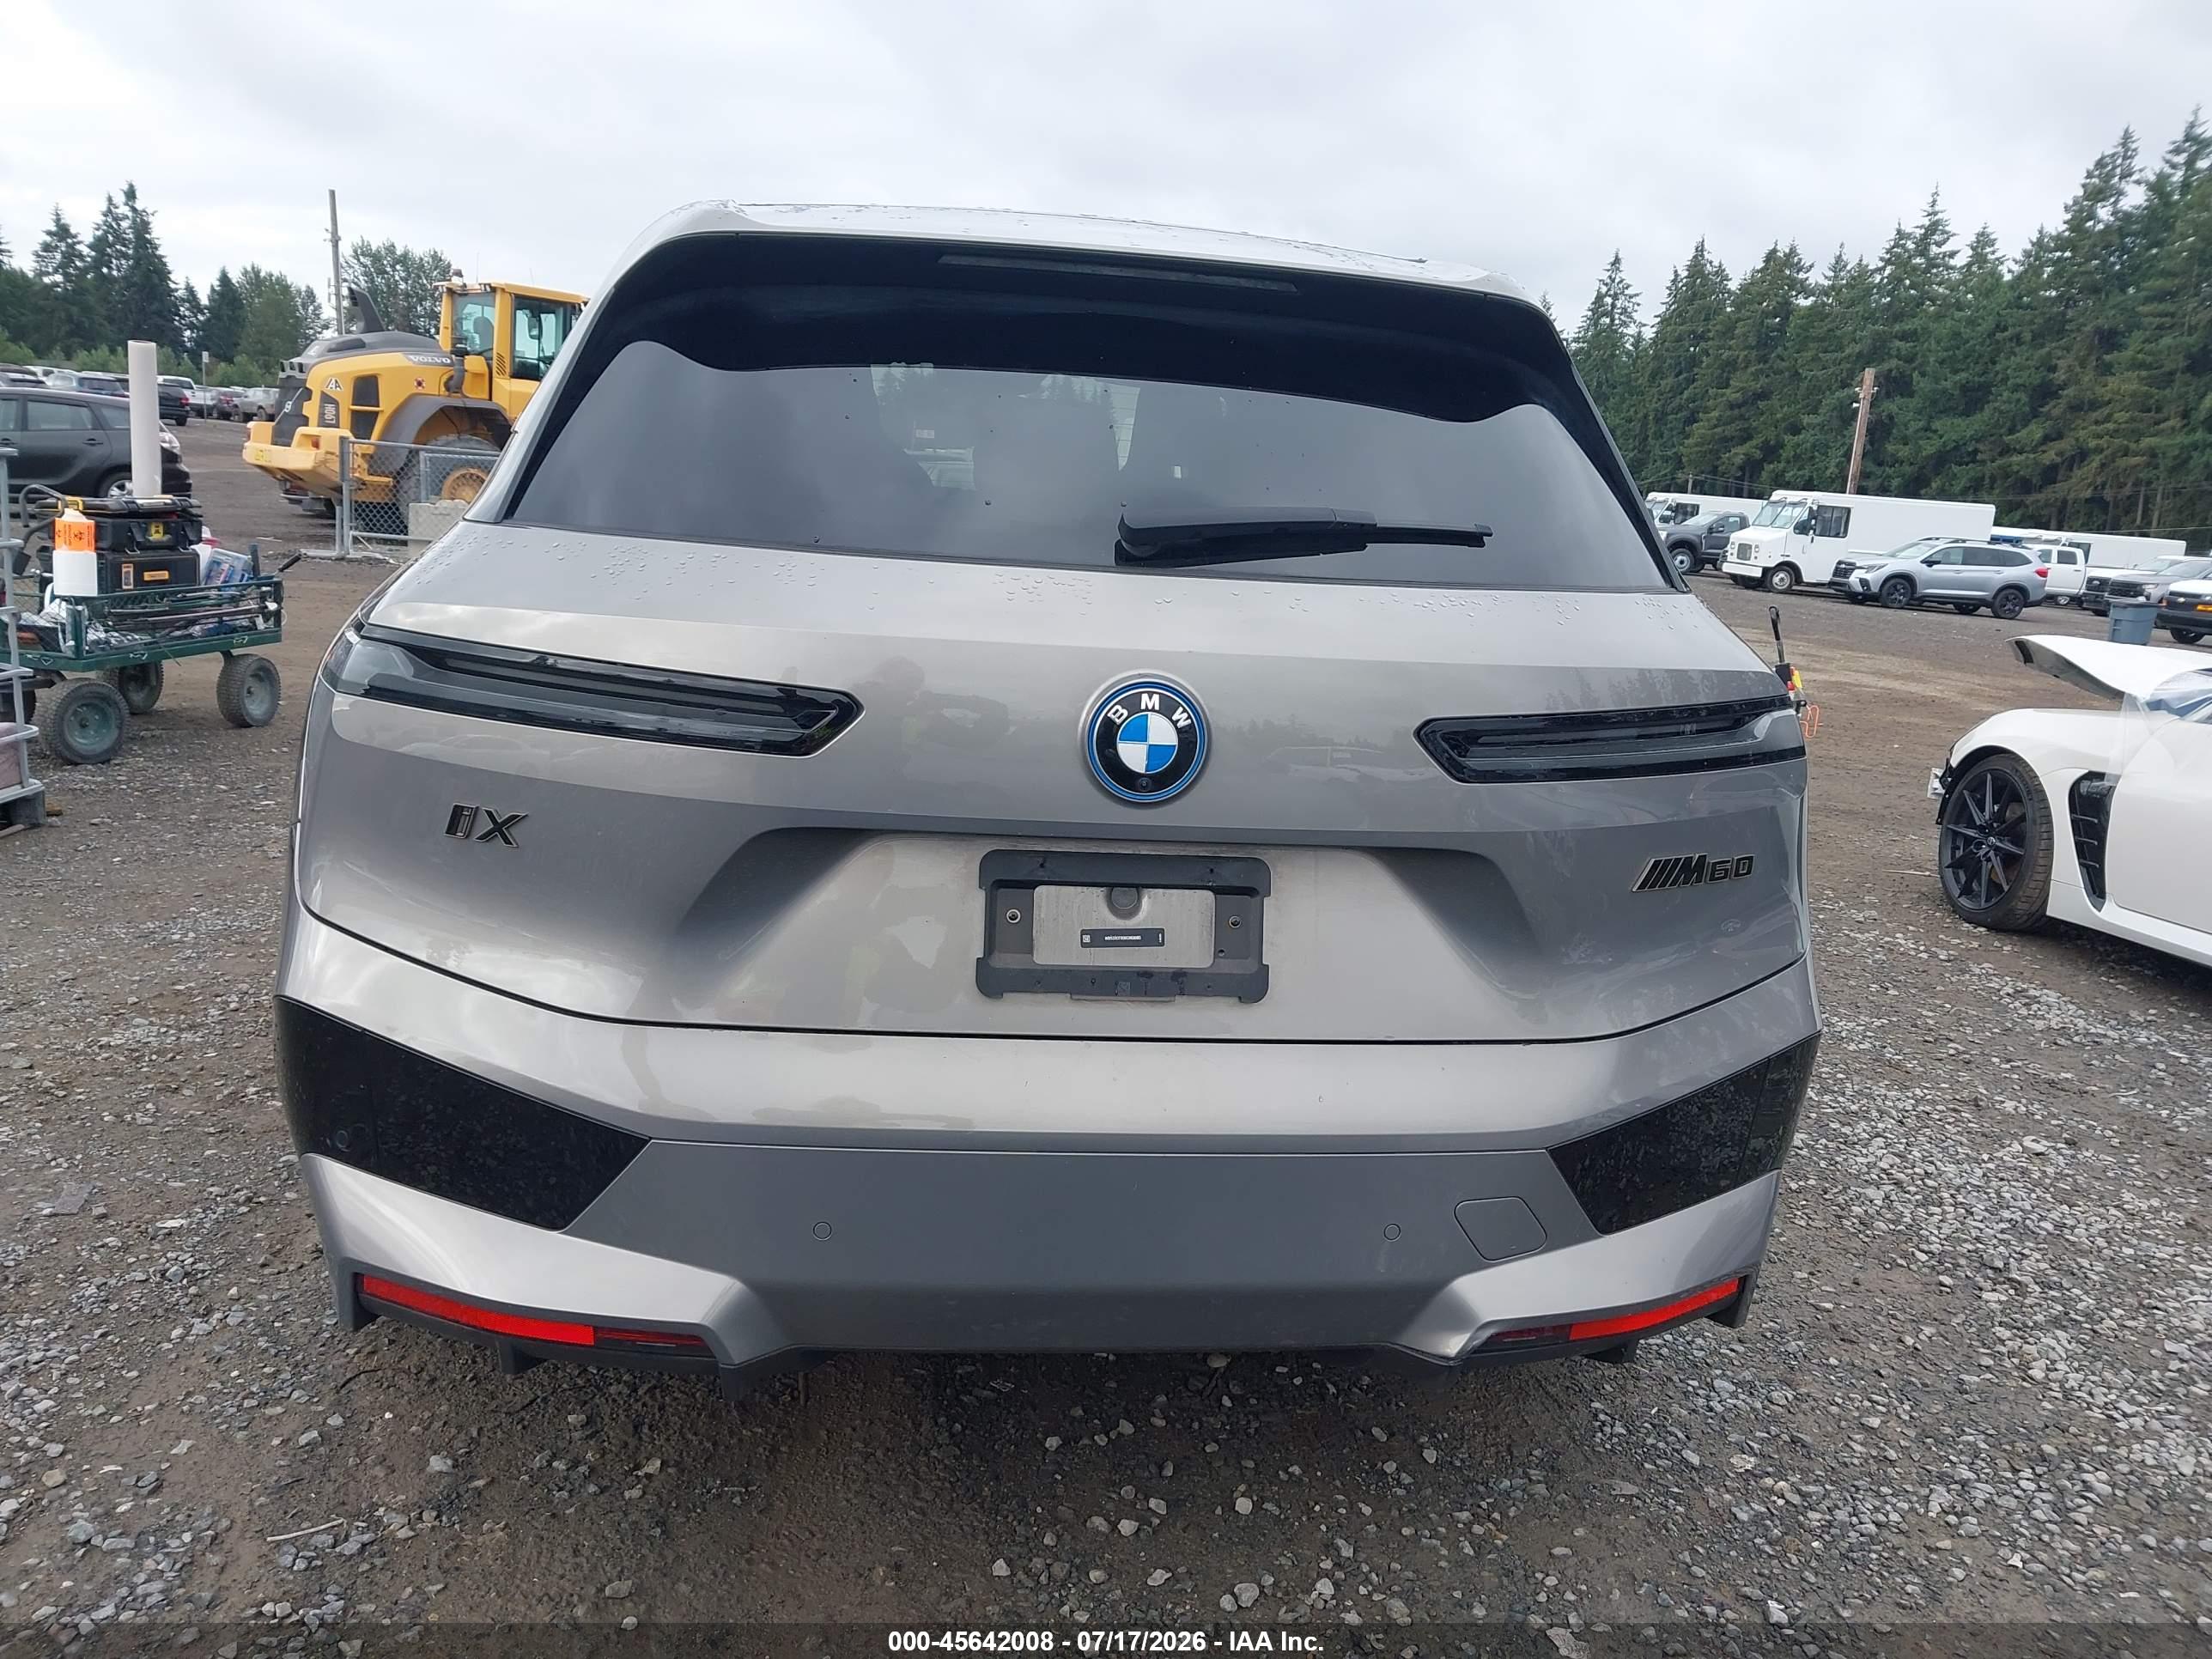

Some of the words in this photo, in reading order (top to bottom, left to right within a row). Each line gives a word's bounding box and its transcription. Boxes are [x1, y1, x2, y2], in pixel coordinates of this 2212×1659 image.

[408, 356, 451, 364] VOLVO
[323, 404, 337, 424] L90H
[1107, 693, 1192, 729] BMW
